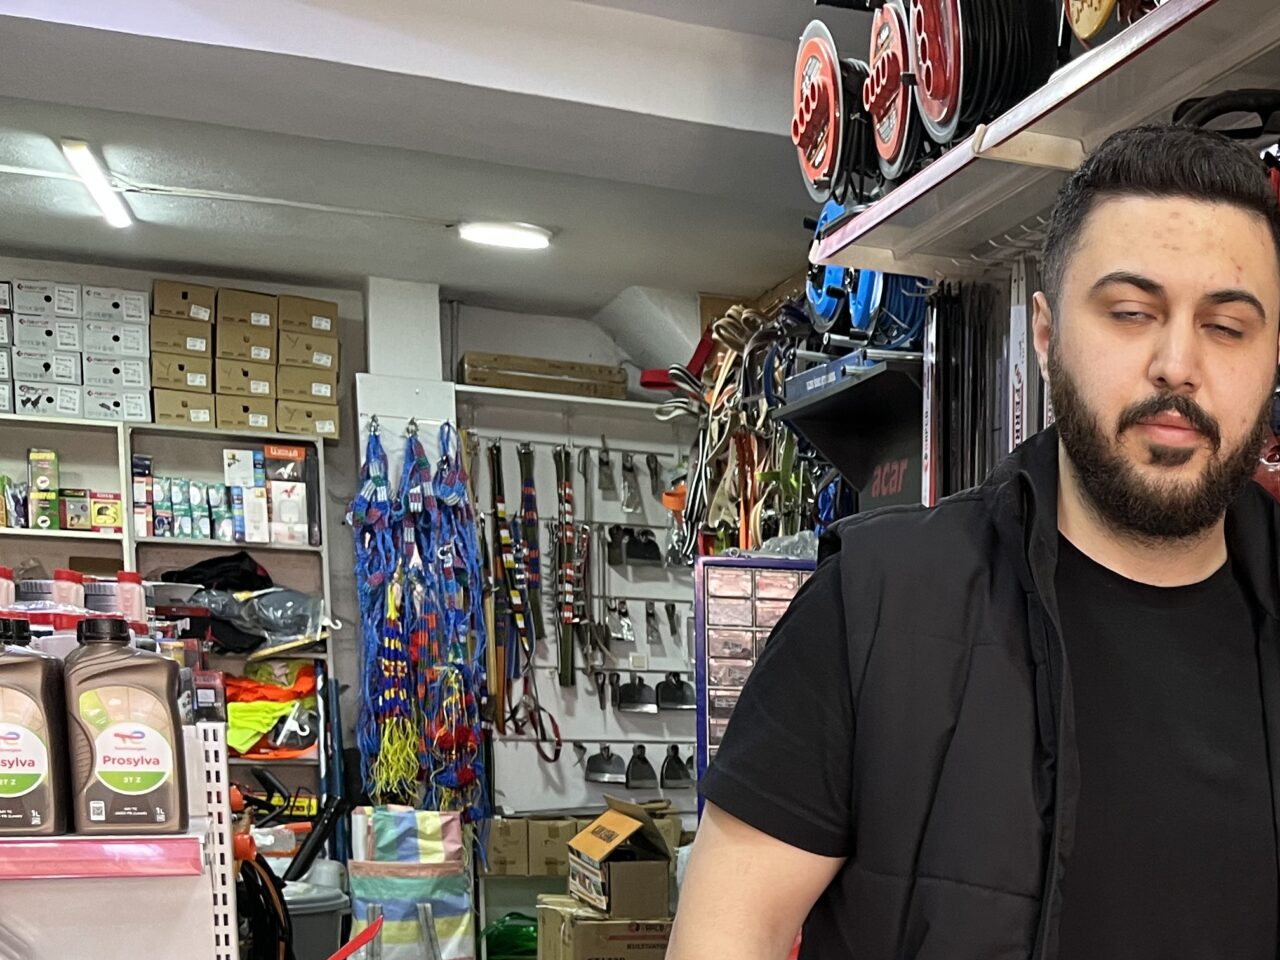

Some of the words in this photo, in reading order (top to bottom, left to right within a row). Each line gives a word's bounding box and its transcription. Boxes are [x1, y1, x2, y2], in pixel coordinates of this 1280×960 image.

[871, 458, 908, 497] acar
[0, 757, 36, 769] sylva
[102, 755, 161, 767] Prosylva
